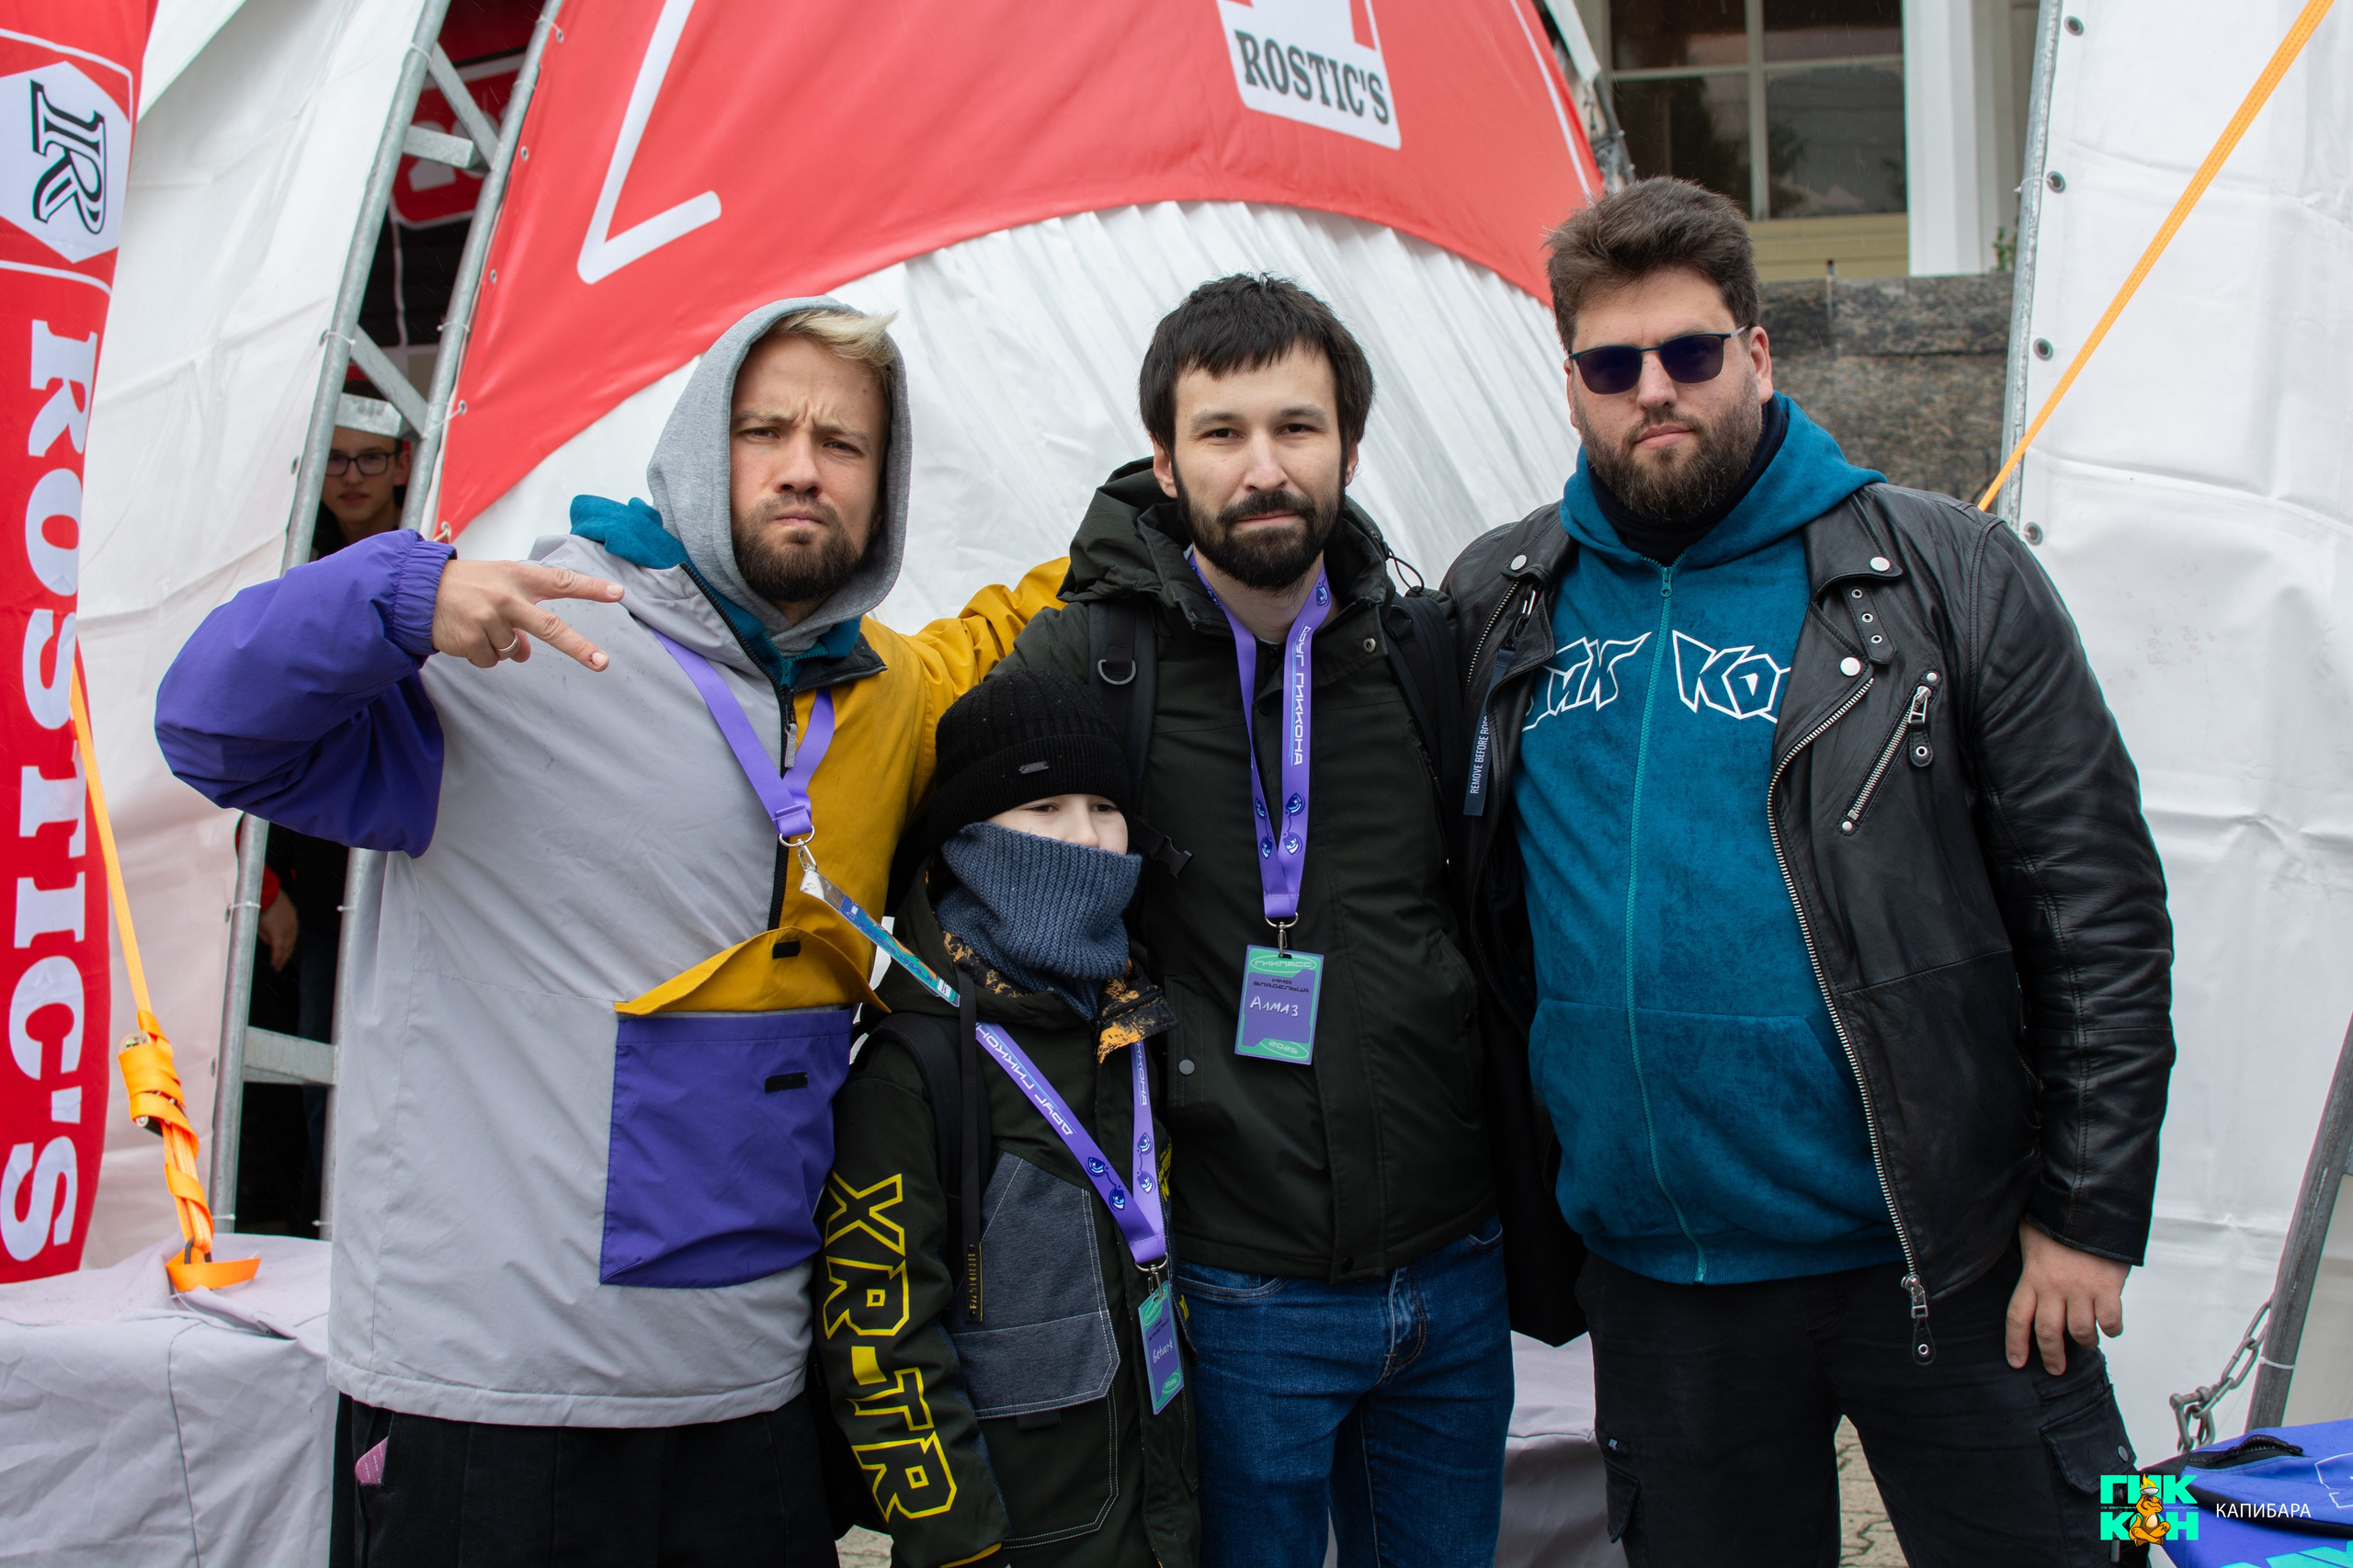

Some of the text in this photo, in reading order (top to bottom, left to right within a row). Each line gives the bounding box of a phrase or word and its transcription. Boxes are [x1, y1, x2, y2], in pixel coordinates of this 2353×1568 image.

[1234, 29, 1391, 126] ROSTIC'S
[1294, 625, 1312, 766] ДРУГ ГИККОНА
[1470, 764, 1483, 794] REMOVE
[1474, 736, 1489, 763] BEFORE
[1, 319, 98, 1262] ROSTIC'S
[1253, 981, 1310, 994] ВЛАДЕЛЬЦА
[1254, 960, 1313, 968] ГИКПАСС
[975, 1022, 1074, 1135] ДРУГ ГИККОН
